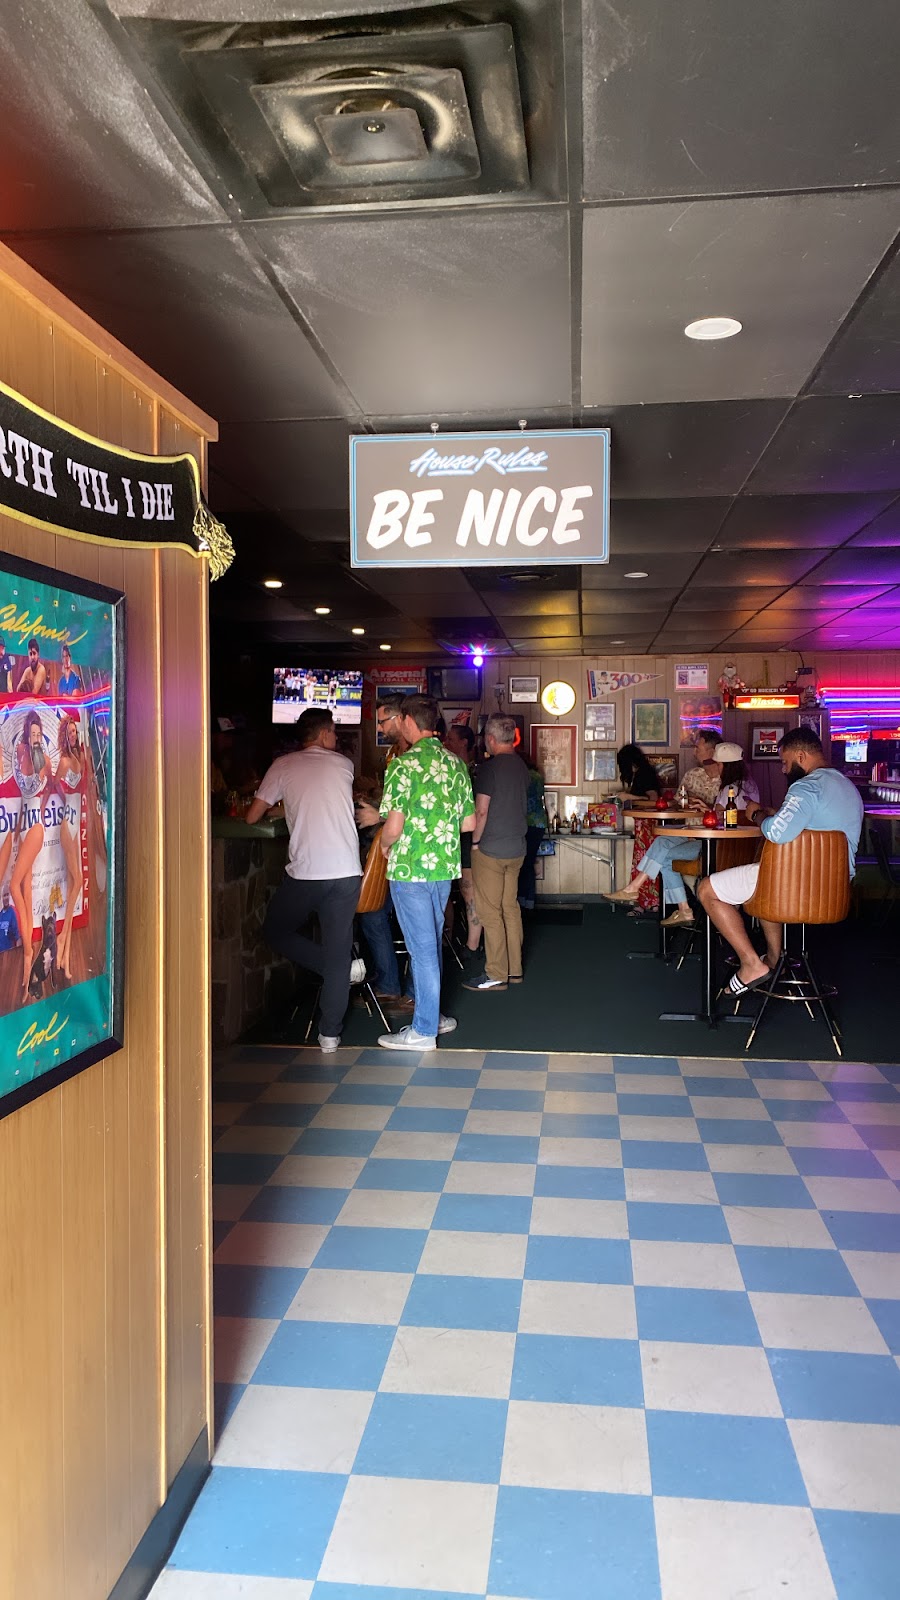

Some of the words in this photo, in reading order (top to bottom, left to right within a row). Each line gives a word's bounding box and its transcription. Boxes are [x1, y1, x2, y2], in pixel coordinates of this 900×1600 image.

[409, 447, 478, 478] House
[473, 445, 548, 476] Rules
[67, 458, 119, 515] 'TIL
[121, 477, 136, 518] I
[138, 480, 175, 521] DIE
[366, 488, 443, 550] BE
[455, 485, 594, 548] NICE
[0, 603, 88, 646] California
[370, 668, 427, 679] Arsenal
[610, 672, 643, 691] 300
[0, 800, 77, 833] Budweiser
[771, 796, 804, 841] COSTA
[17, 1011, 70, 1057] Cool
